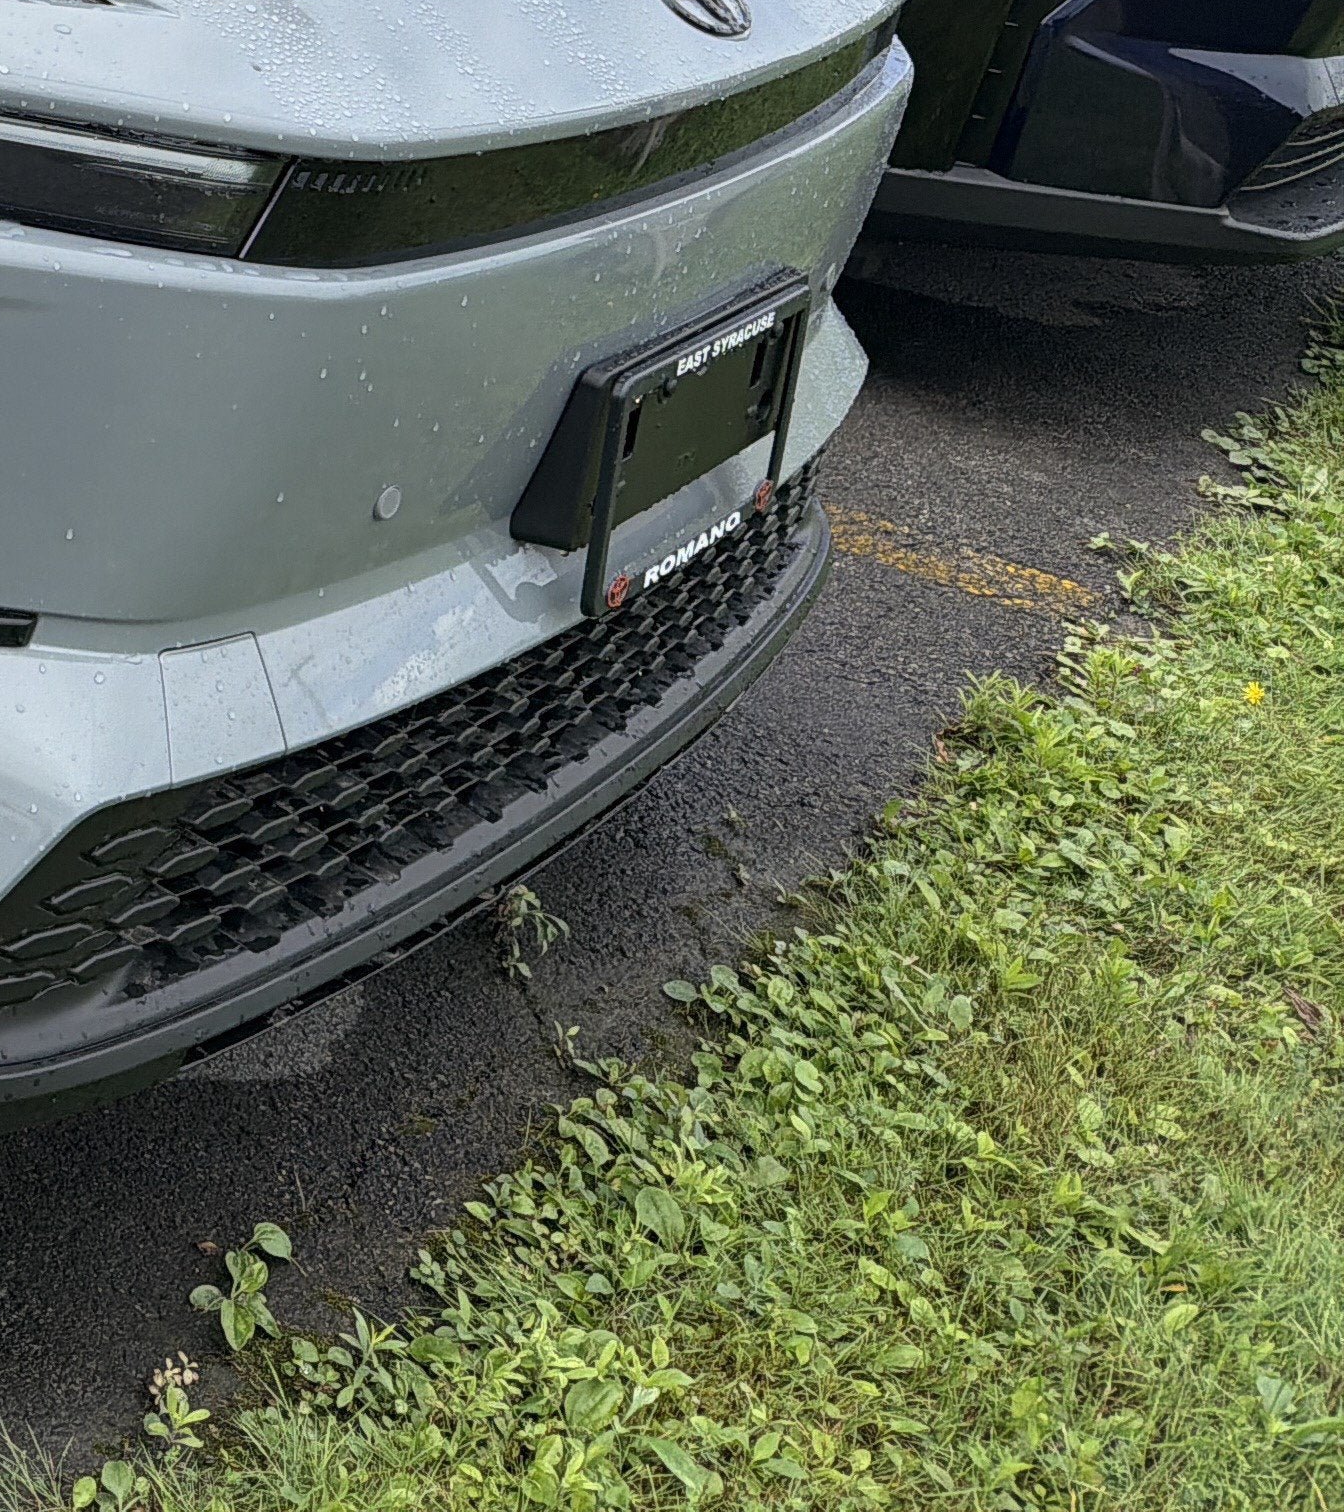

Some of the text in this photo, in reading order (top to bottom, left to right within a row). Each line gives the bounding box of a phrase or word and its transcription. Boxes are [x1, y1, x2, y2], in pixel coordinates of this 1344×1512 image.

[677, 311, 776, 376] EAST SYRACUSE
[643, 511, 742, 589] ROMANO
